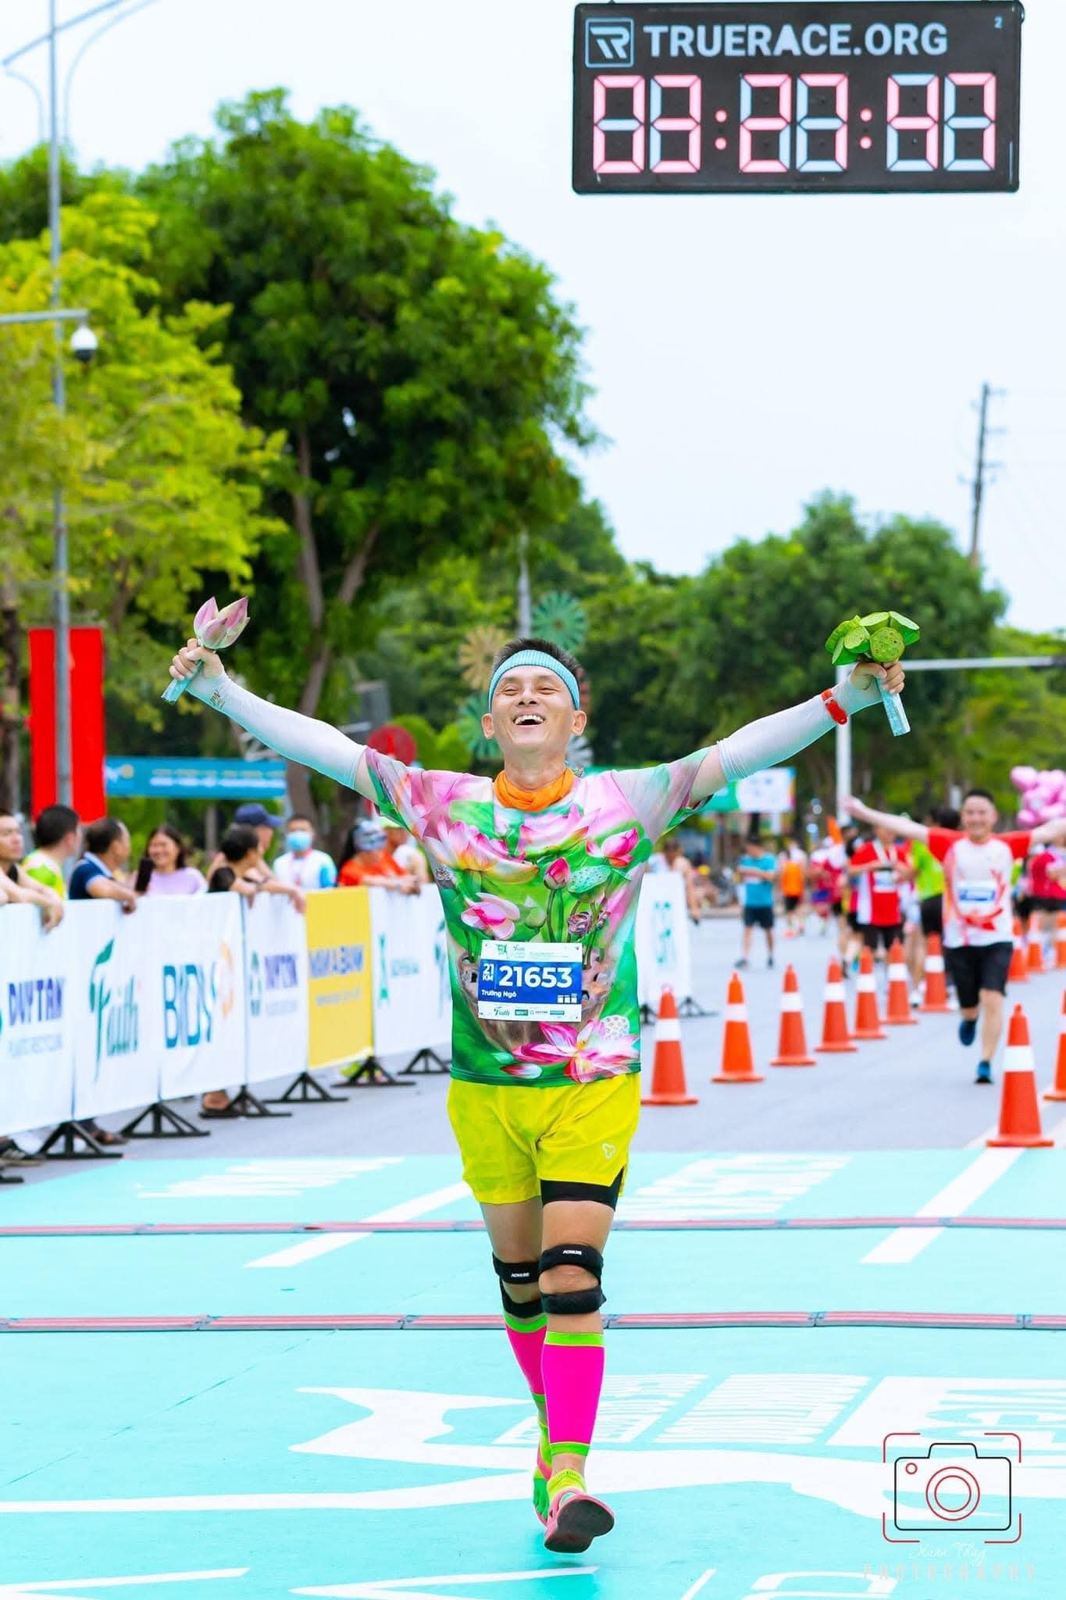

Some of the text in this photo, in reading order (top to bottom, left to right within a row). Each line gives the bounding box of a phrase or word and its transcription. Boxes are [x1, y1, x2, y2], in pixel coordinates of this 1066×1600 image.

[994, 16, 1003, 29] 2
[642, 24, 948, 57] TRUERACE.ORG
[593, 73, 997, 173] 03:27:47
[483, 963, 494, 974] 21
[498, 965, 573, 988] 21653
